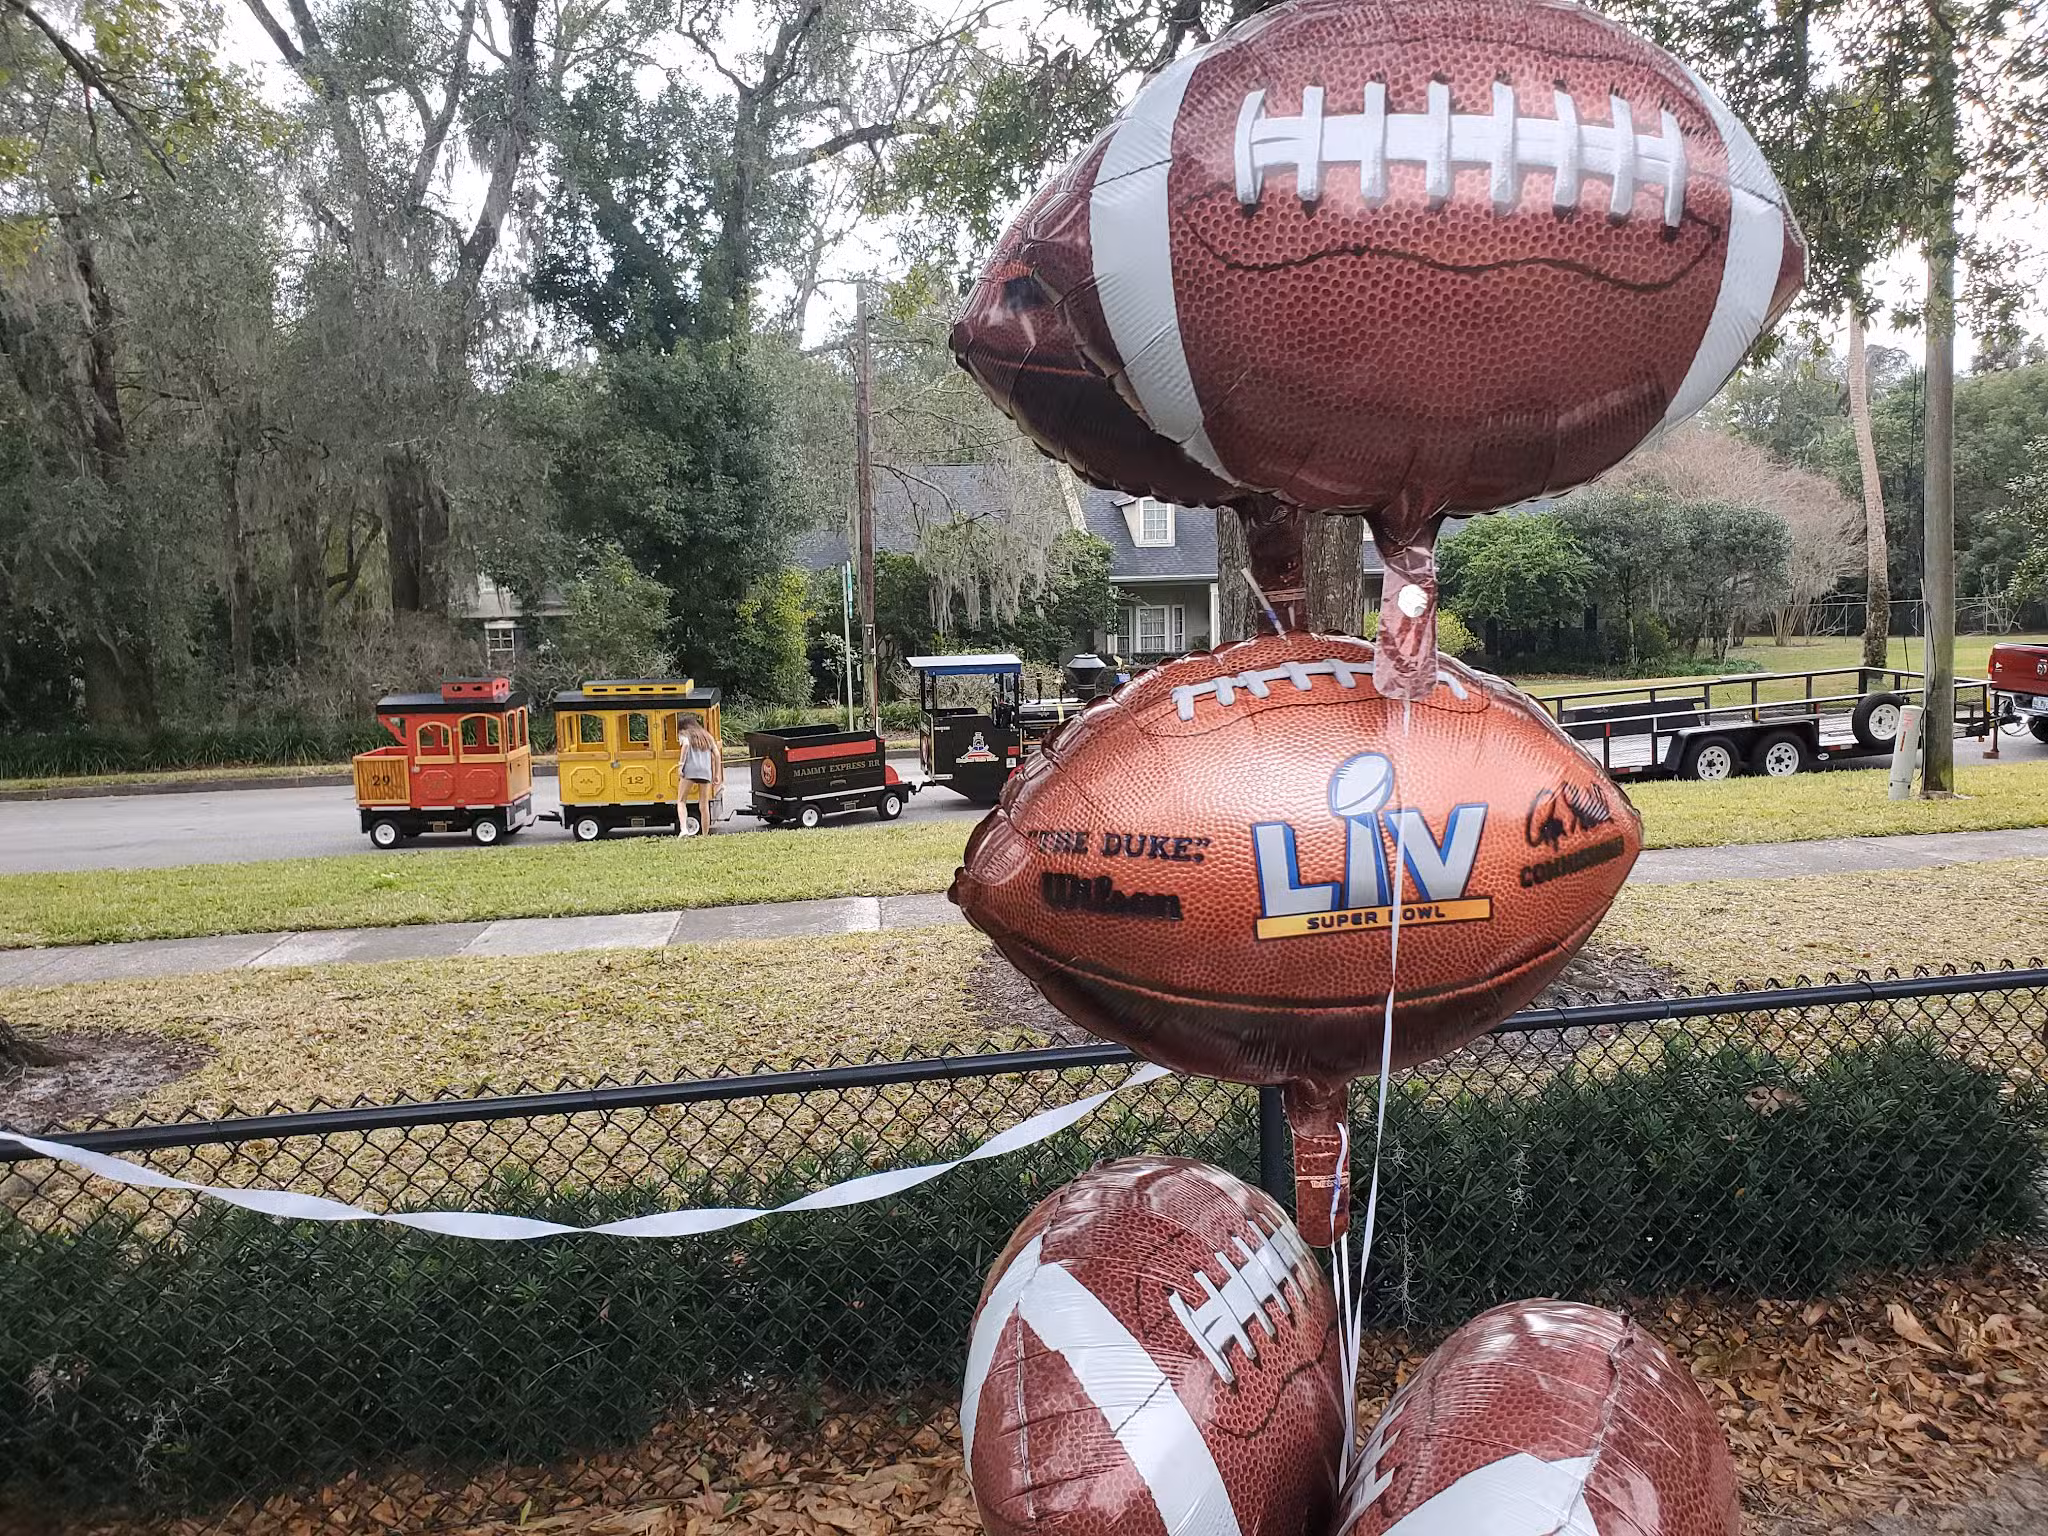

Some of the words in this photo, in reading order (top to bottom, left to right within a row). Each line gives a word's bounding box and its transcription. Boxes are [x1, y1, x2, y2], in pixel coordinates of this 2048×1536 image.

[793, 766, 826, 777] MAMMY
[830, 761, 866, 773] EXPRESS
[372, 774, 391, 786] 29
[626, 775, 645, 785] 12
[1251, 802, 1490, 917] LIV
[1306, 910, 1379, 930] SUPER
